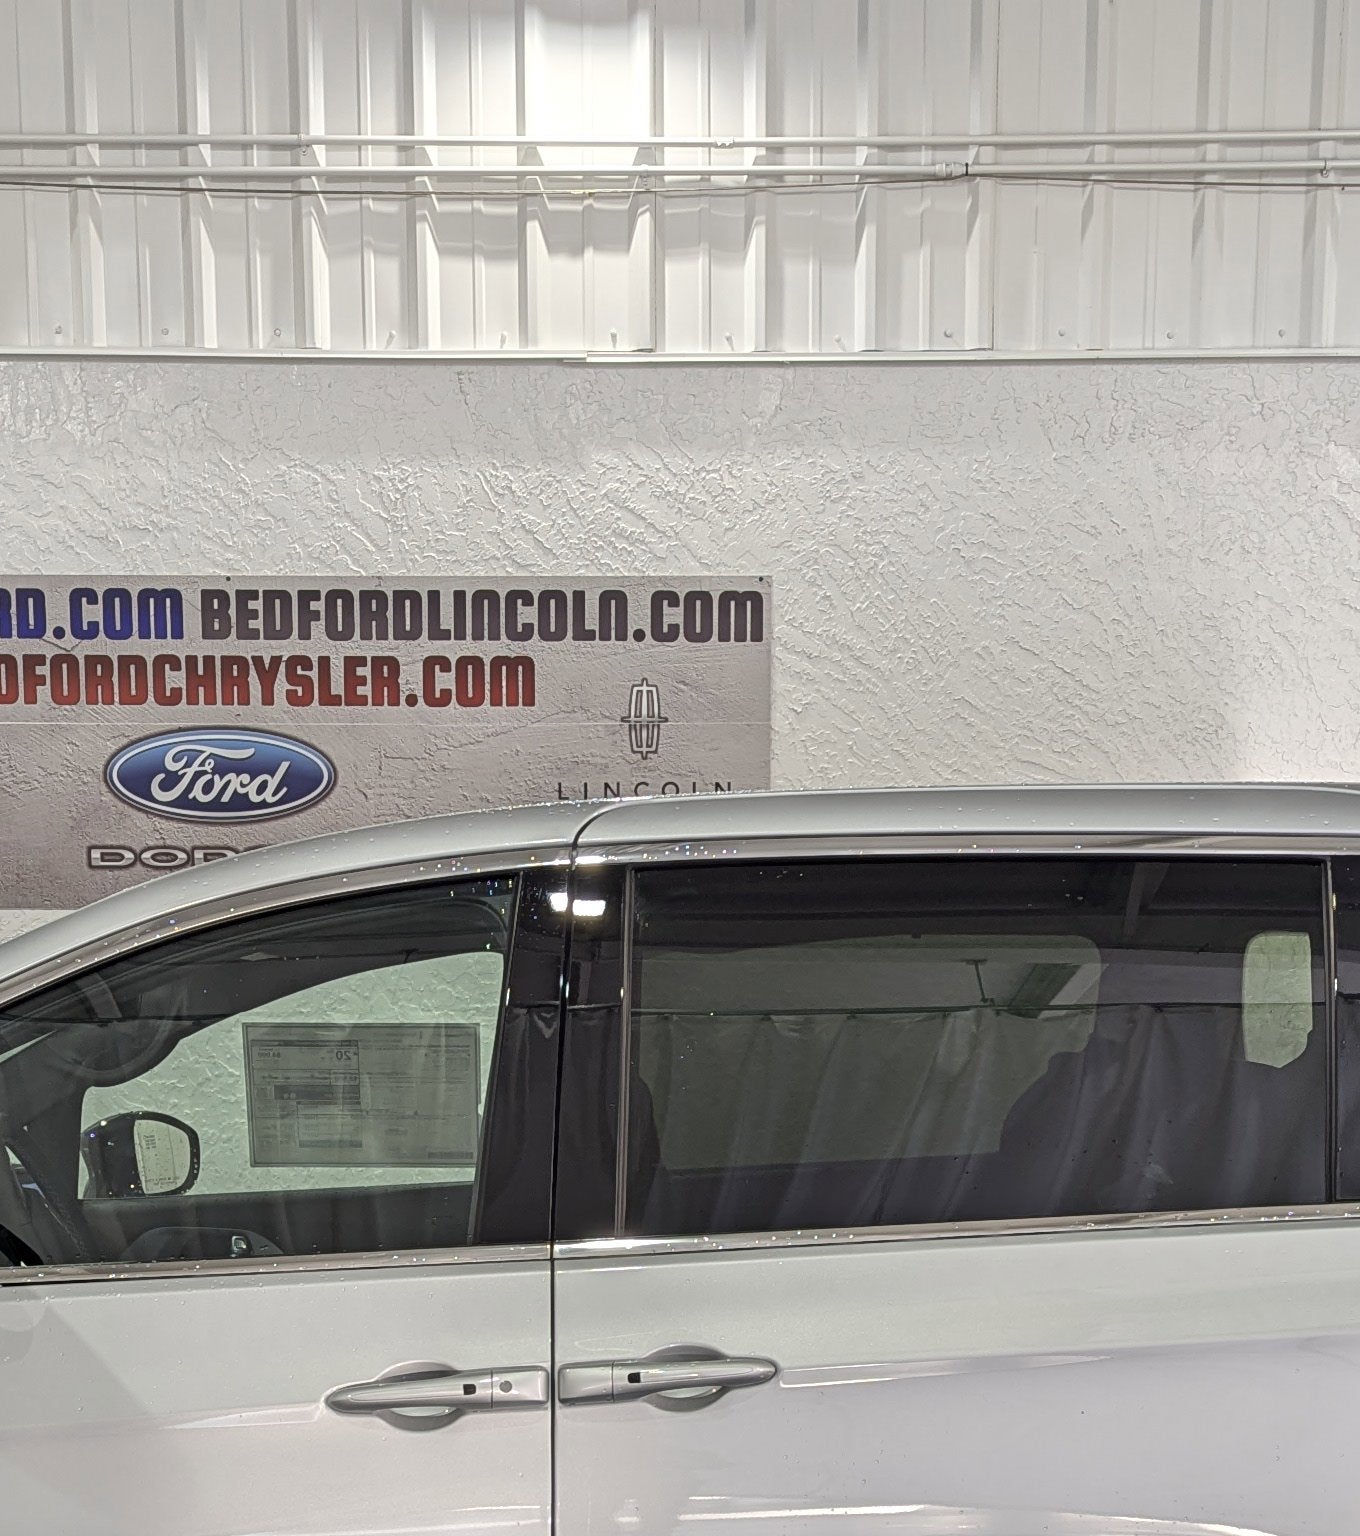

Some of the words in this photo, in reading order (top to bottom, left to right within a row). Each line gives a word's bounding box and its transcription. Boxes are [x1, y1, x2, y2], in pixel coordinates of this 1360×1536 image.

[200, 588, 764, 643] BEDFORDLINCOLN.COM
[150, 744, 291, 803] Ford
[89, 846, 262, 868] DOD
